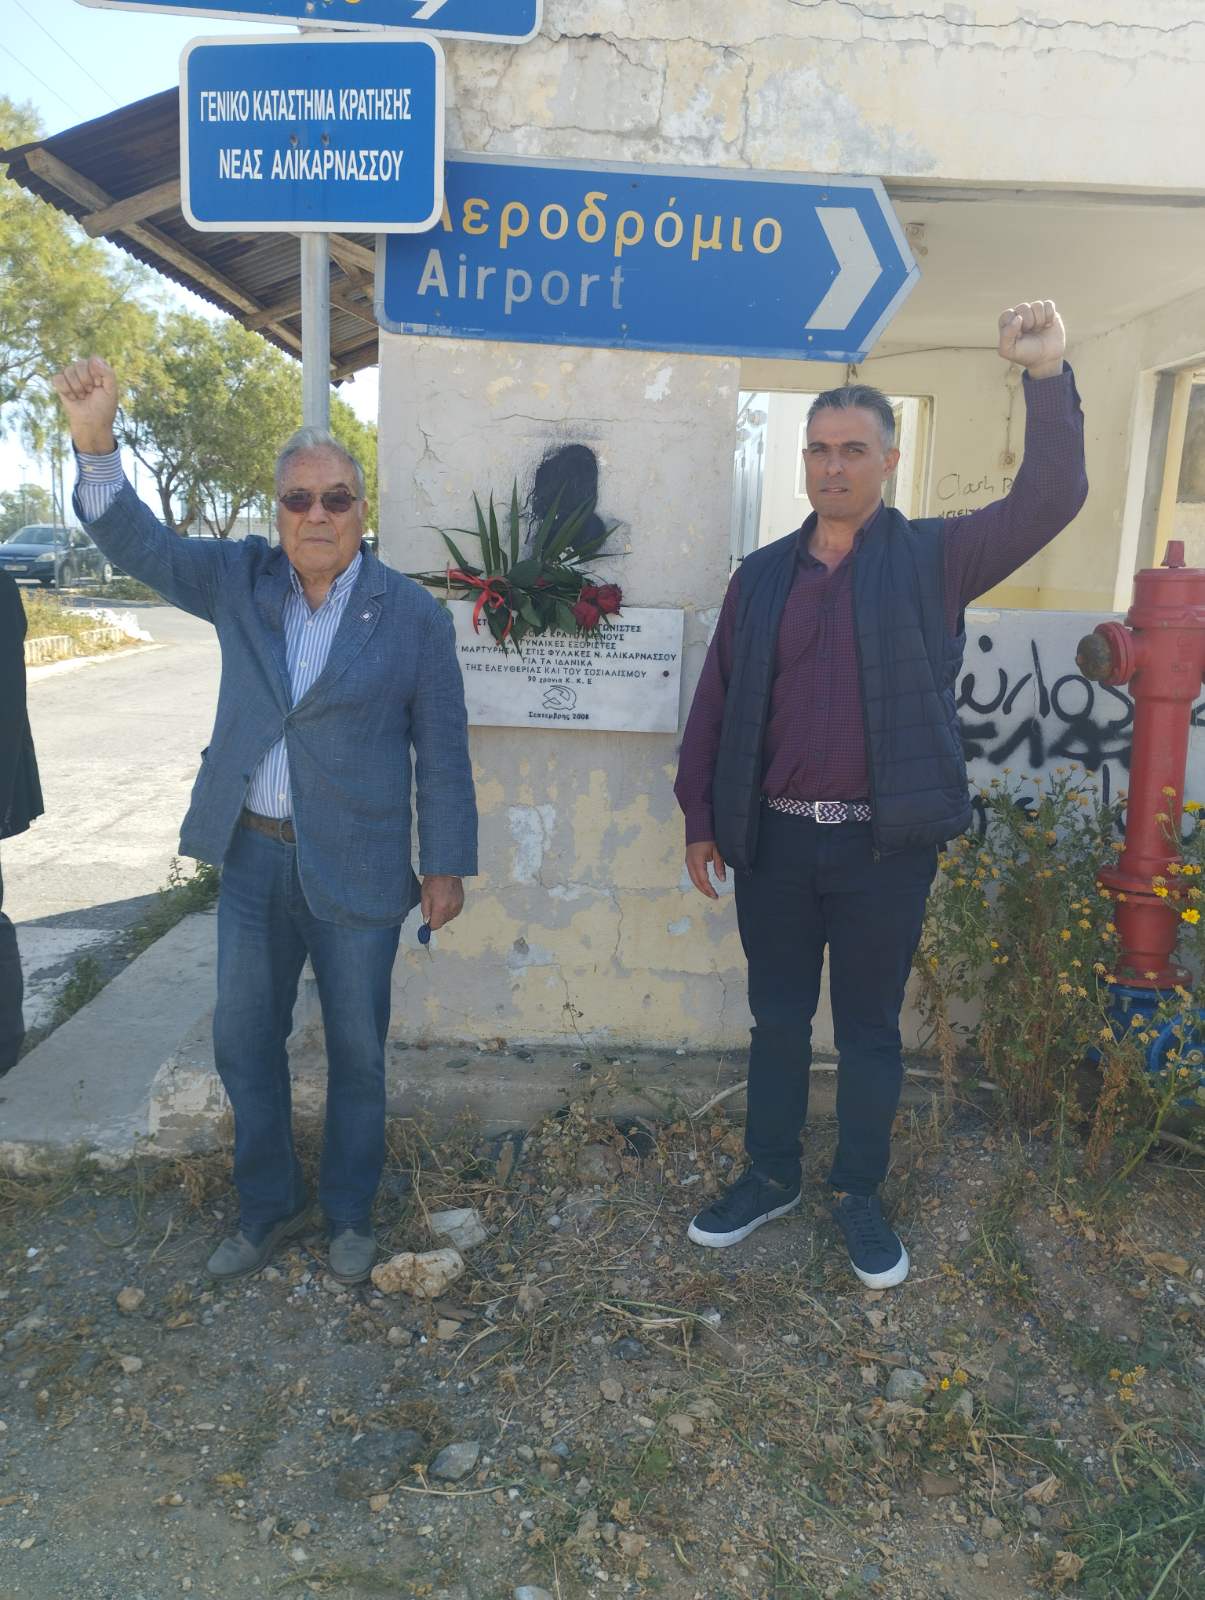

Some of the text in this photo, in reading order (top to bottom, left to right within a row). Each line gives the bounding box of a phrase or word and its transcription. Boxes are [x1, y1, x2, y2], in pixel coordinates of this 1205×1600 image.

[200, 88, 412, 122] ΓΕΝΙΚΟ ΚΑΤΑΣΤΗΜΑ ΚΡΑΤΗΣΗΣ
[218, 149, 404, 181] ΝΕΑΣ ΑΛΙΚΑΡΝΑΣΣΟΥ
[416, 248, 624, 314] Airport
[522, 657, 593, 667] ΓΙΑ ΤΑ ΙΔΑΝΙΚΑ
[525, 648, 546, 656] ΣΤΙΣ
[547, 649, 591, 658] ΦΥΛΑΚΕΣ
[605, 653, 677, 662] ΑΛΙΚΑΡΝΑΣΣΟΥ
[465, 663, 482, 672] ΤΗΣ
[485, 664, 541, 675] ΕΛΕΥΘΕΡΙΑΣ
[584, 670, 647, 679] ΣΟΣΙΑΛΙΣΜΟΥ
